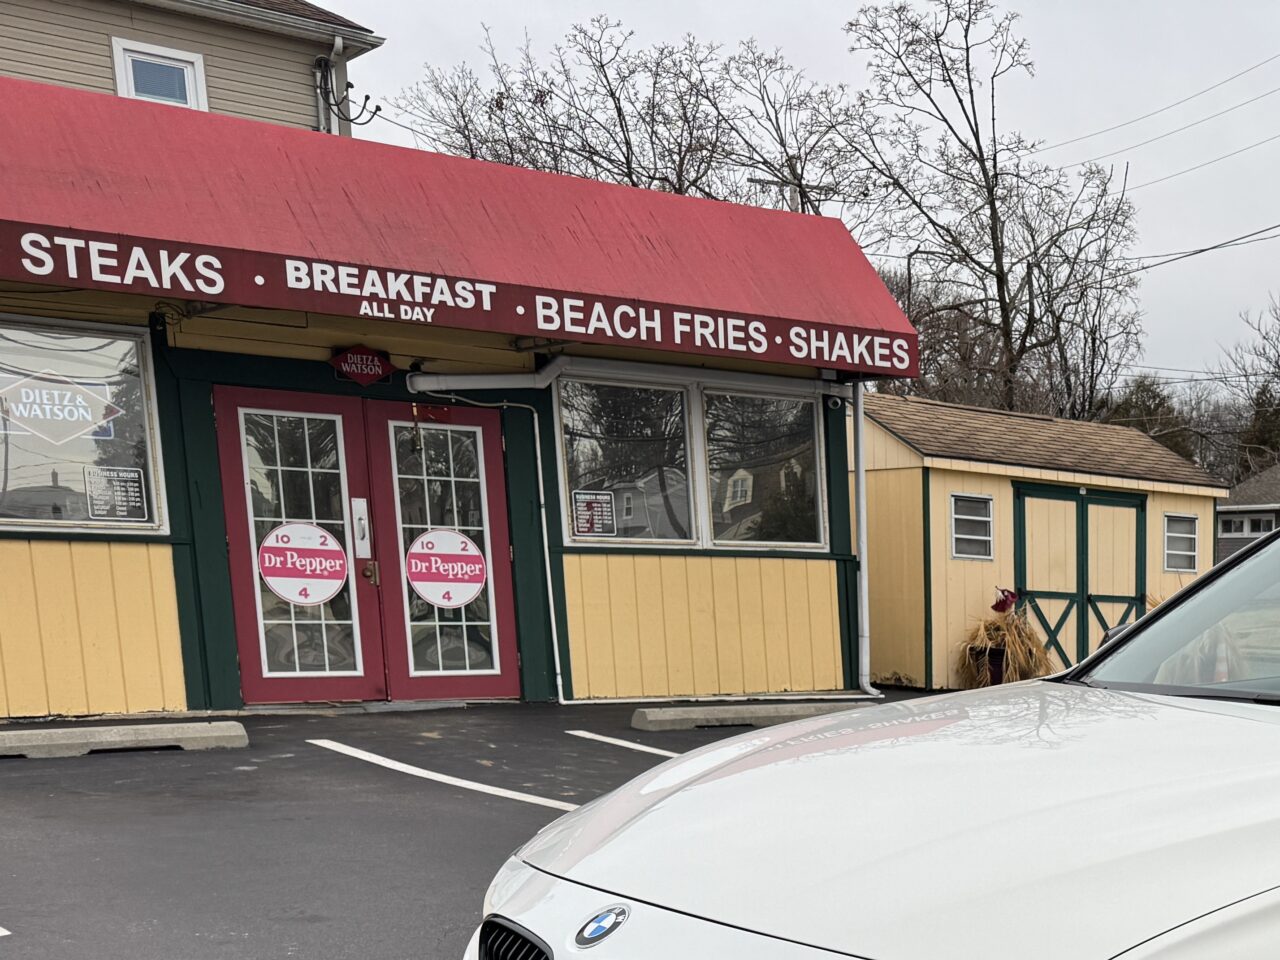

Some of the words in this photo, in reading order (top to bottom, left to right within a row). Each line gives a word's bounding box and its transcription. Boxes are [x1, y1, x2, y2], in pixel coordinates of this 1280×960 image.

[20, 233, 226, 295] STEAKS
[285, 259, 497, 312] BREAKFAST
[359, 301, 395, 320] ALL
[400, 304, 435, 323] DAY
[535, 295, 662, 343] BEACH
[673, 312, 768, 354] FRIES
[789, 326, 910, 370] SHAKES
[347, 353, 372, 365] DIETZ
[341, 362, 382, 375] WATSON
[21, 388, 72, 406] DIETZ
[76, 394, 88, 406] &
[10, 403, 92, 421] WATSON
[275, 534, 291, 544] 10
[319, 535, 328, 546] 2
[421, 541, 435, 550] 10
[460, 541, 469, 552] 2
[263, 553, 284, 568] Dr
[285, 551, 343, 575] Pepper
[410, 558, 429, 573] Dr
[430, 556, 482, 579] Pepper
[298, 587, 310, 599] 4
[442, 591, 452, 602] 4
